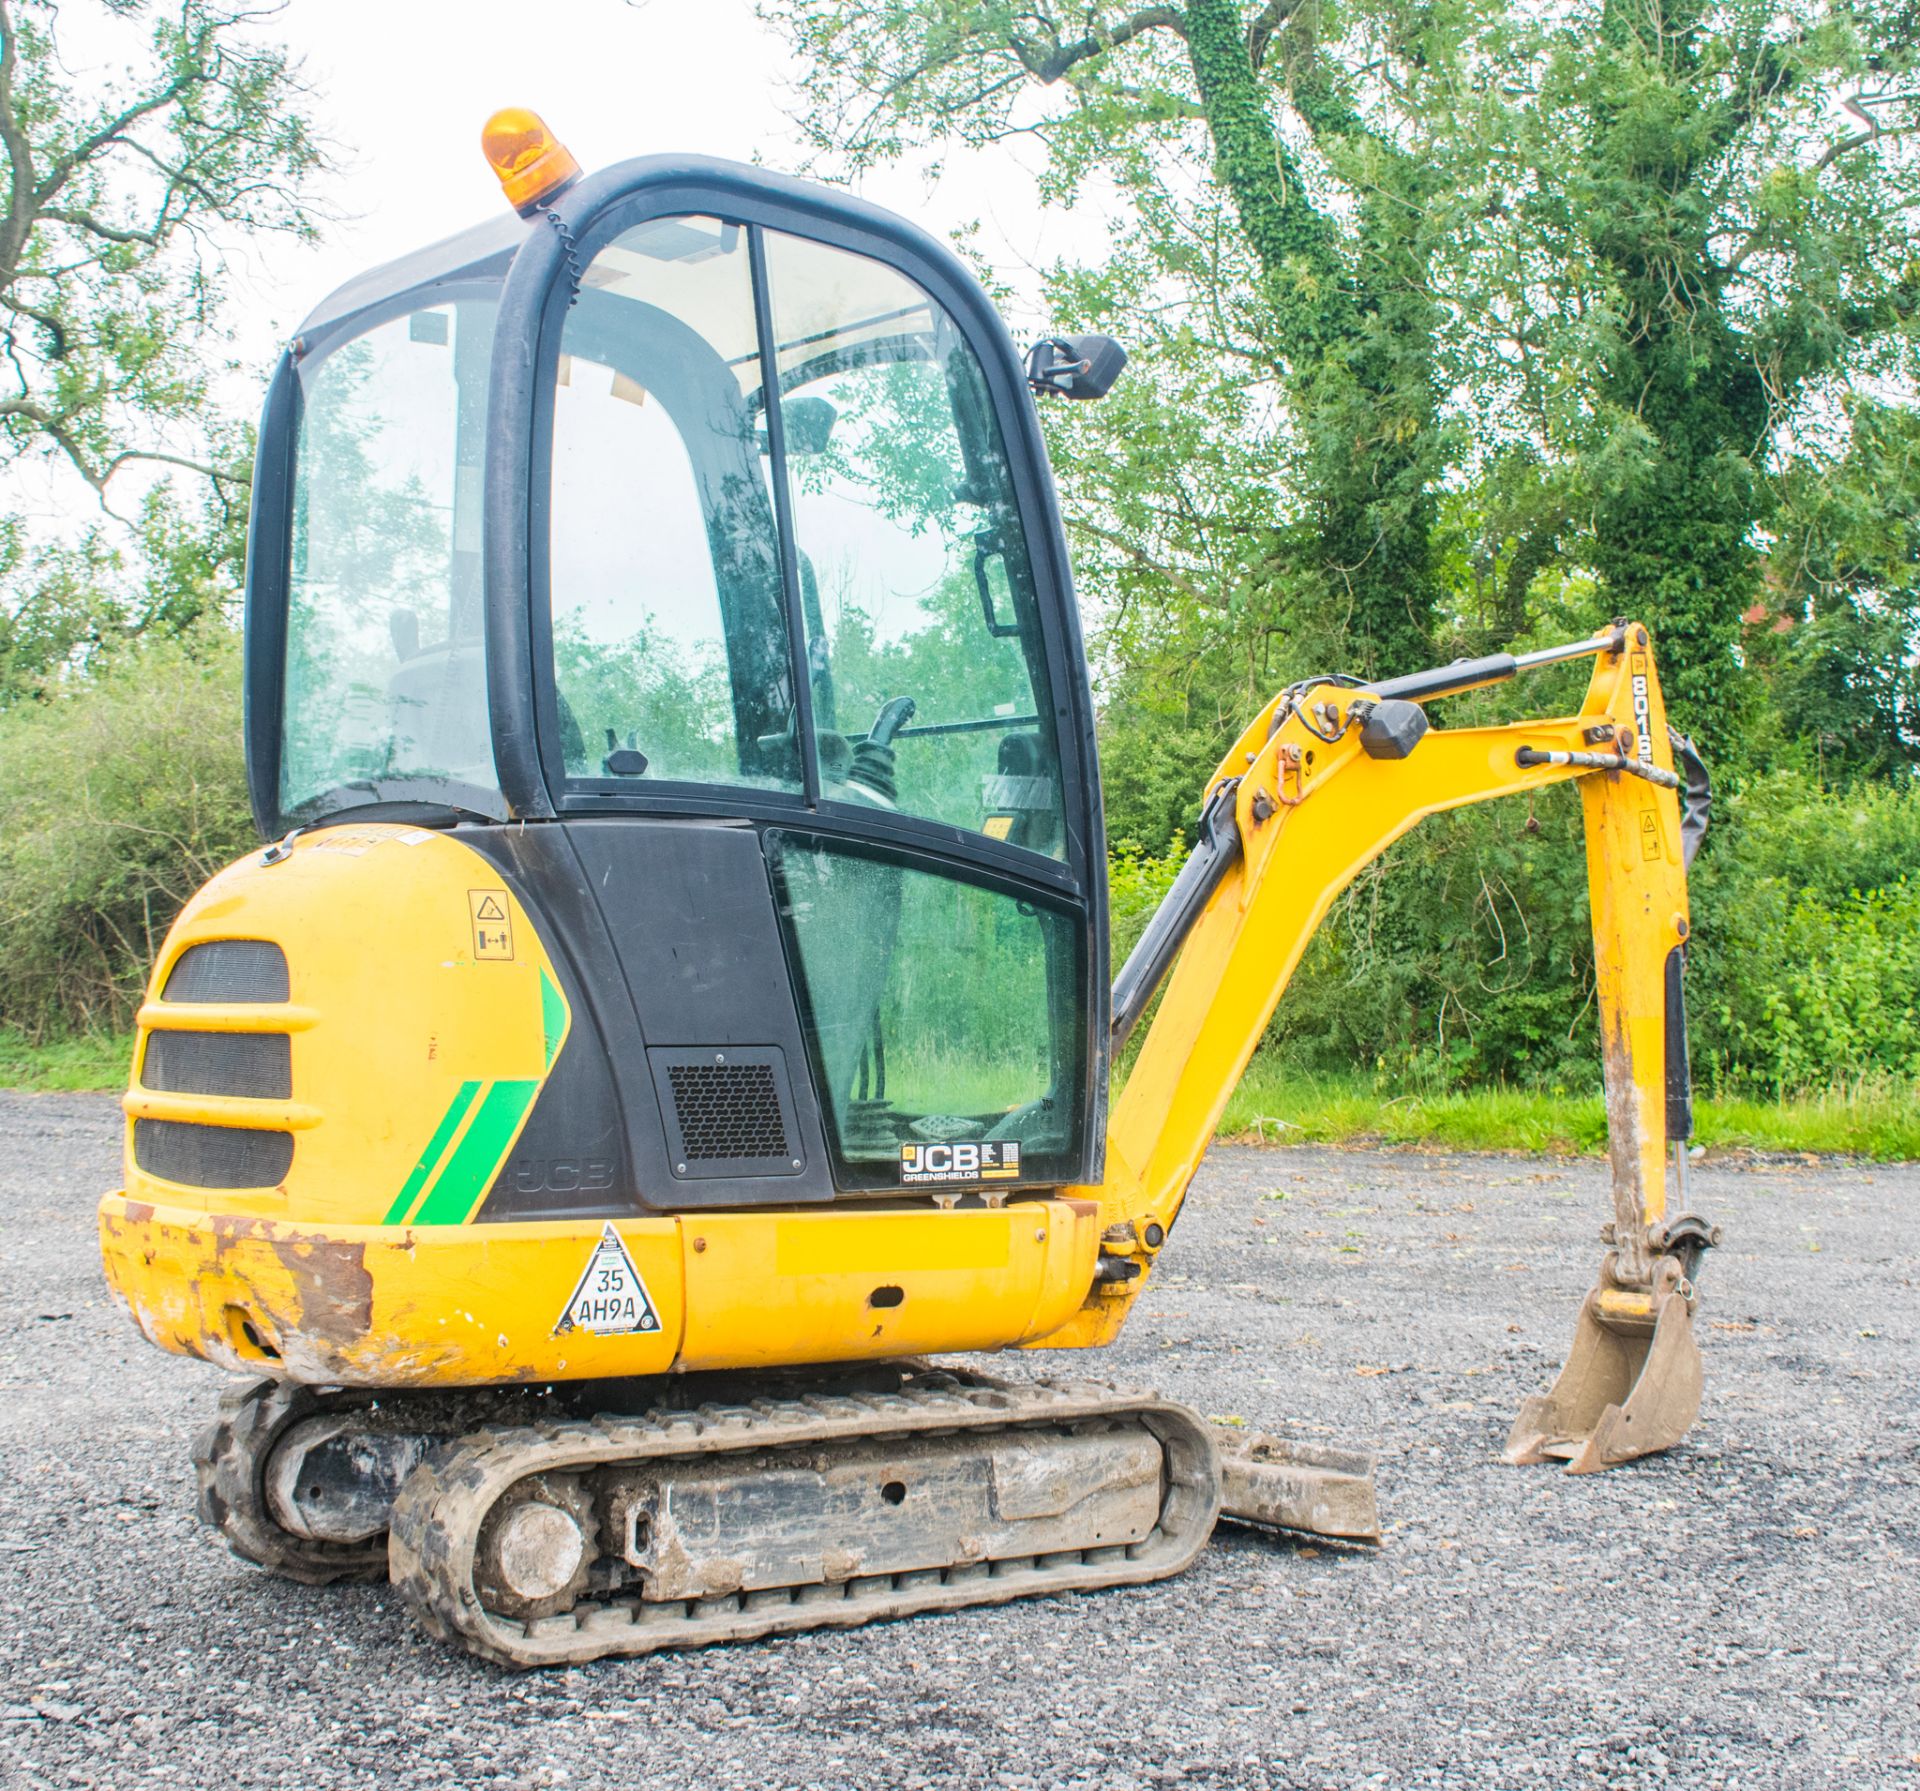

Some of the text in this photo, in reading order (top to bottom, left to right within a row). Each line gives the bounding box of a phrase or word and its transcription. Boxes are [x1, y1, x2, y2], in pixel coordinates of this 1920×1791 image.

[1632, 675, 1651, 755] 8016
[902, 1144, 979, 1173] JCB
[516, 1158, 615, 1193] JCB
[903, 1171, 979, 1182] GREENSHIELDS
[597, 1269, 624, 1293] 35
[578, 1297, 635, 1322] AH9A
